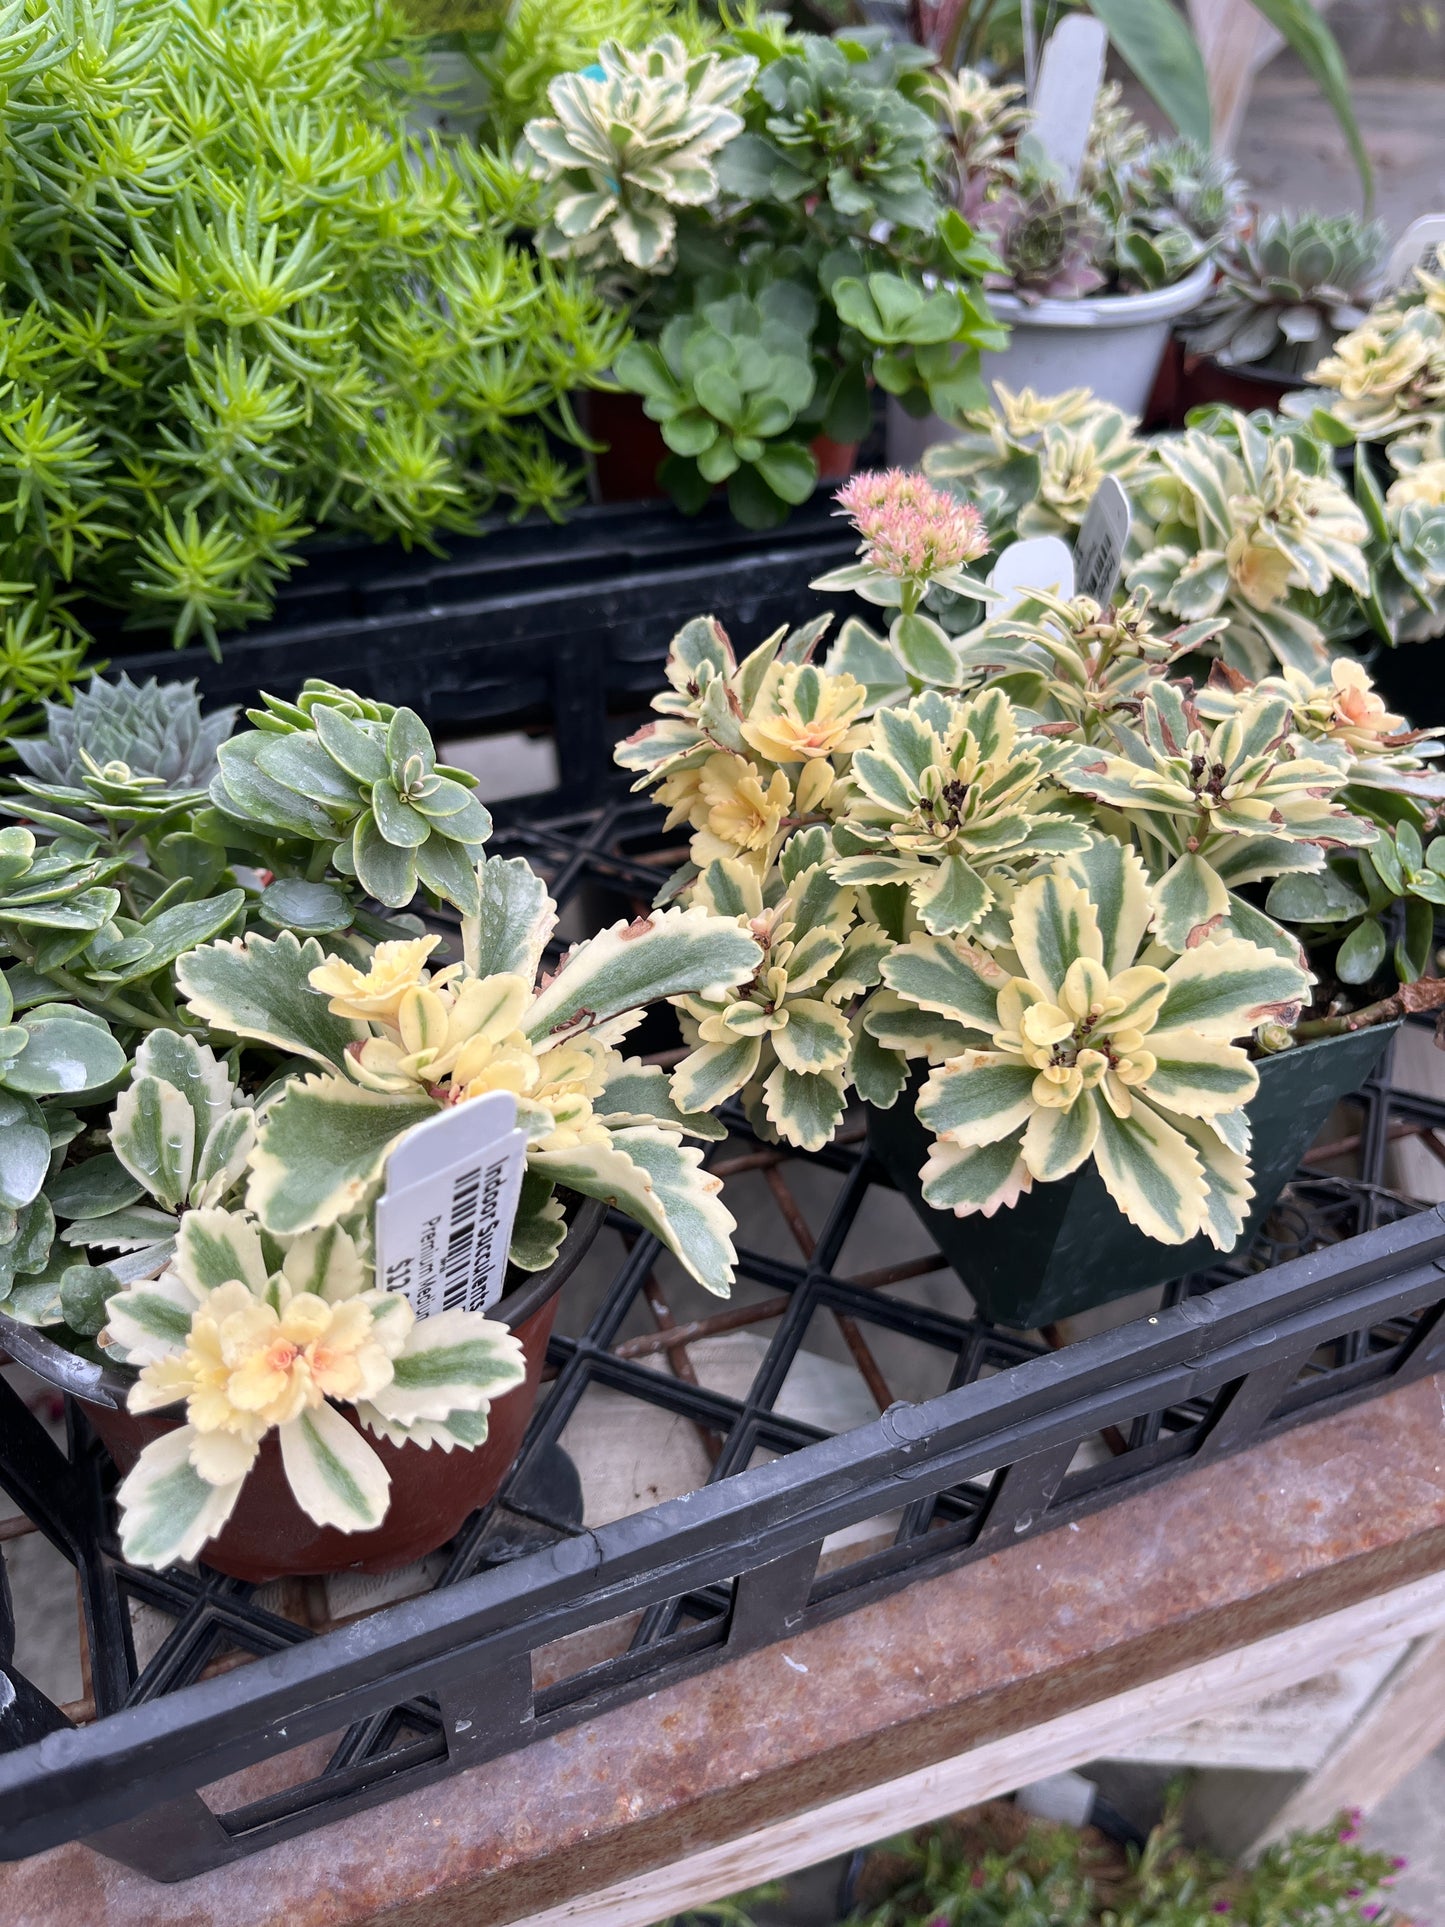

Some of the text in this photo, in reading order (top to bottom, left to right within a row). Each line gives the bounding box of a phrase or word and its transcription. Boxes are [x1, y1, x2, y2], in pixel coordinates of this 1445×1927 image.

[418, 1215, 441, 1278] Premium
[469, 1155, 509, 1312] Indoor Succulents
